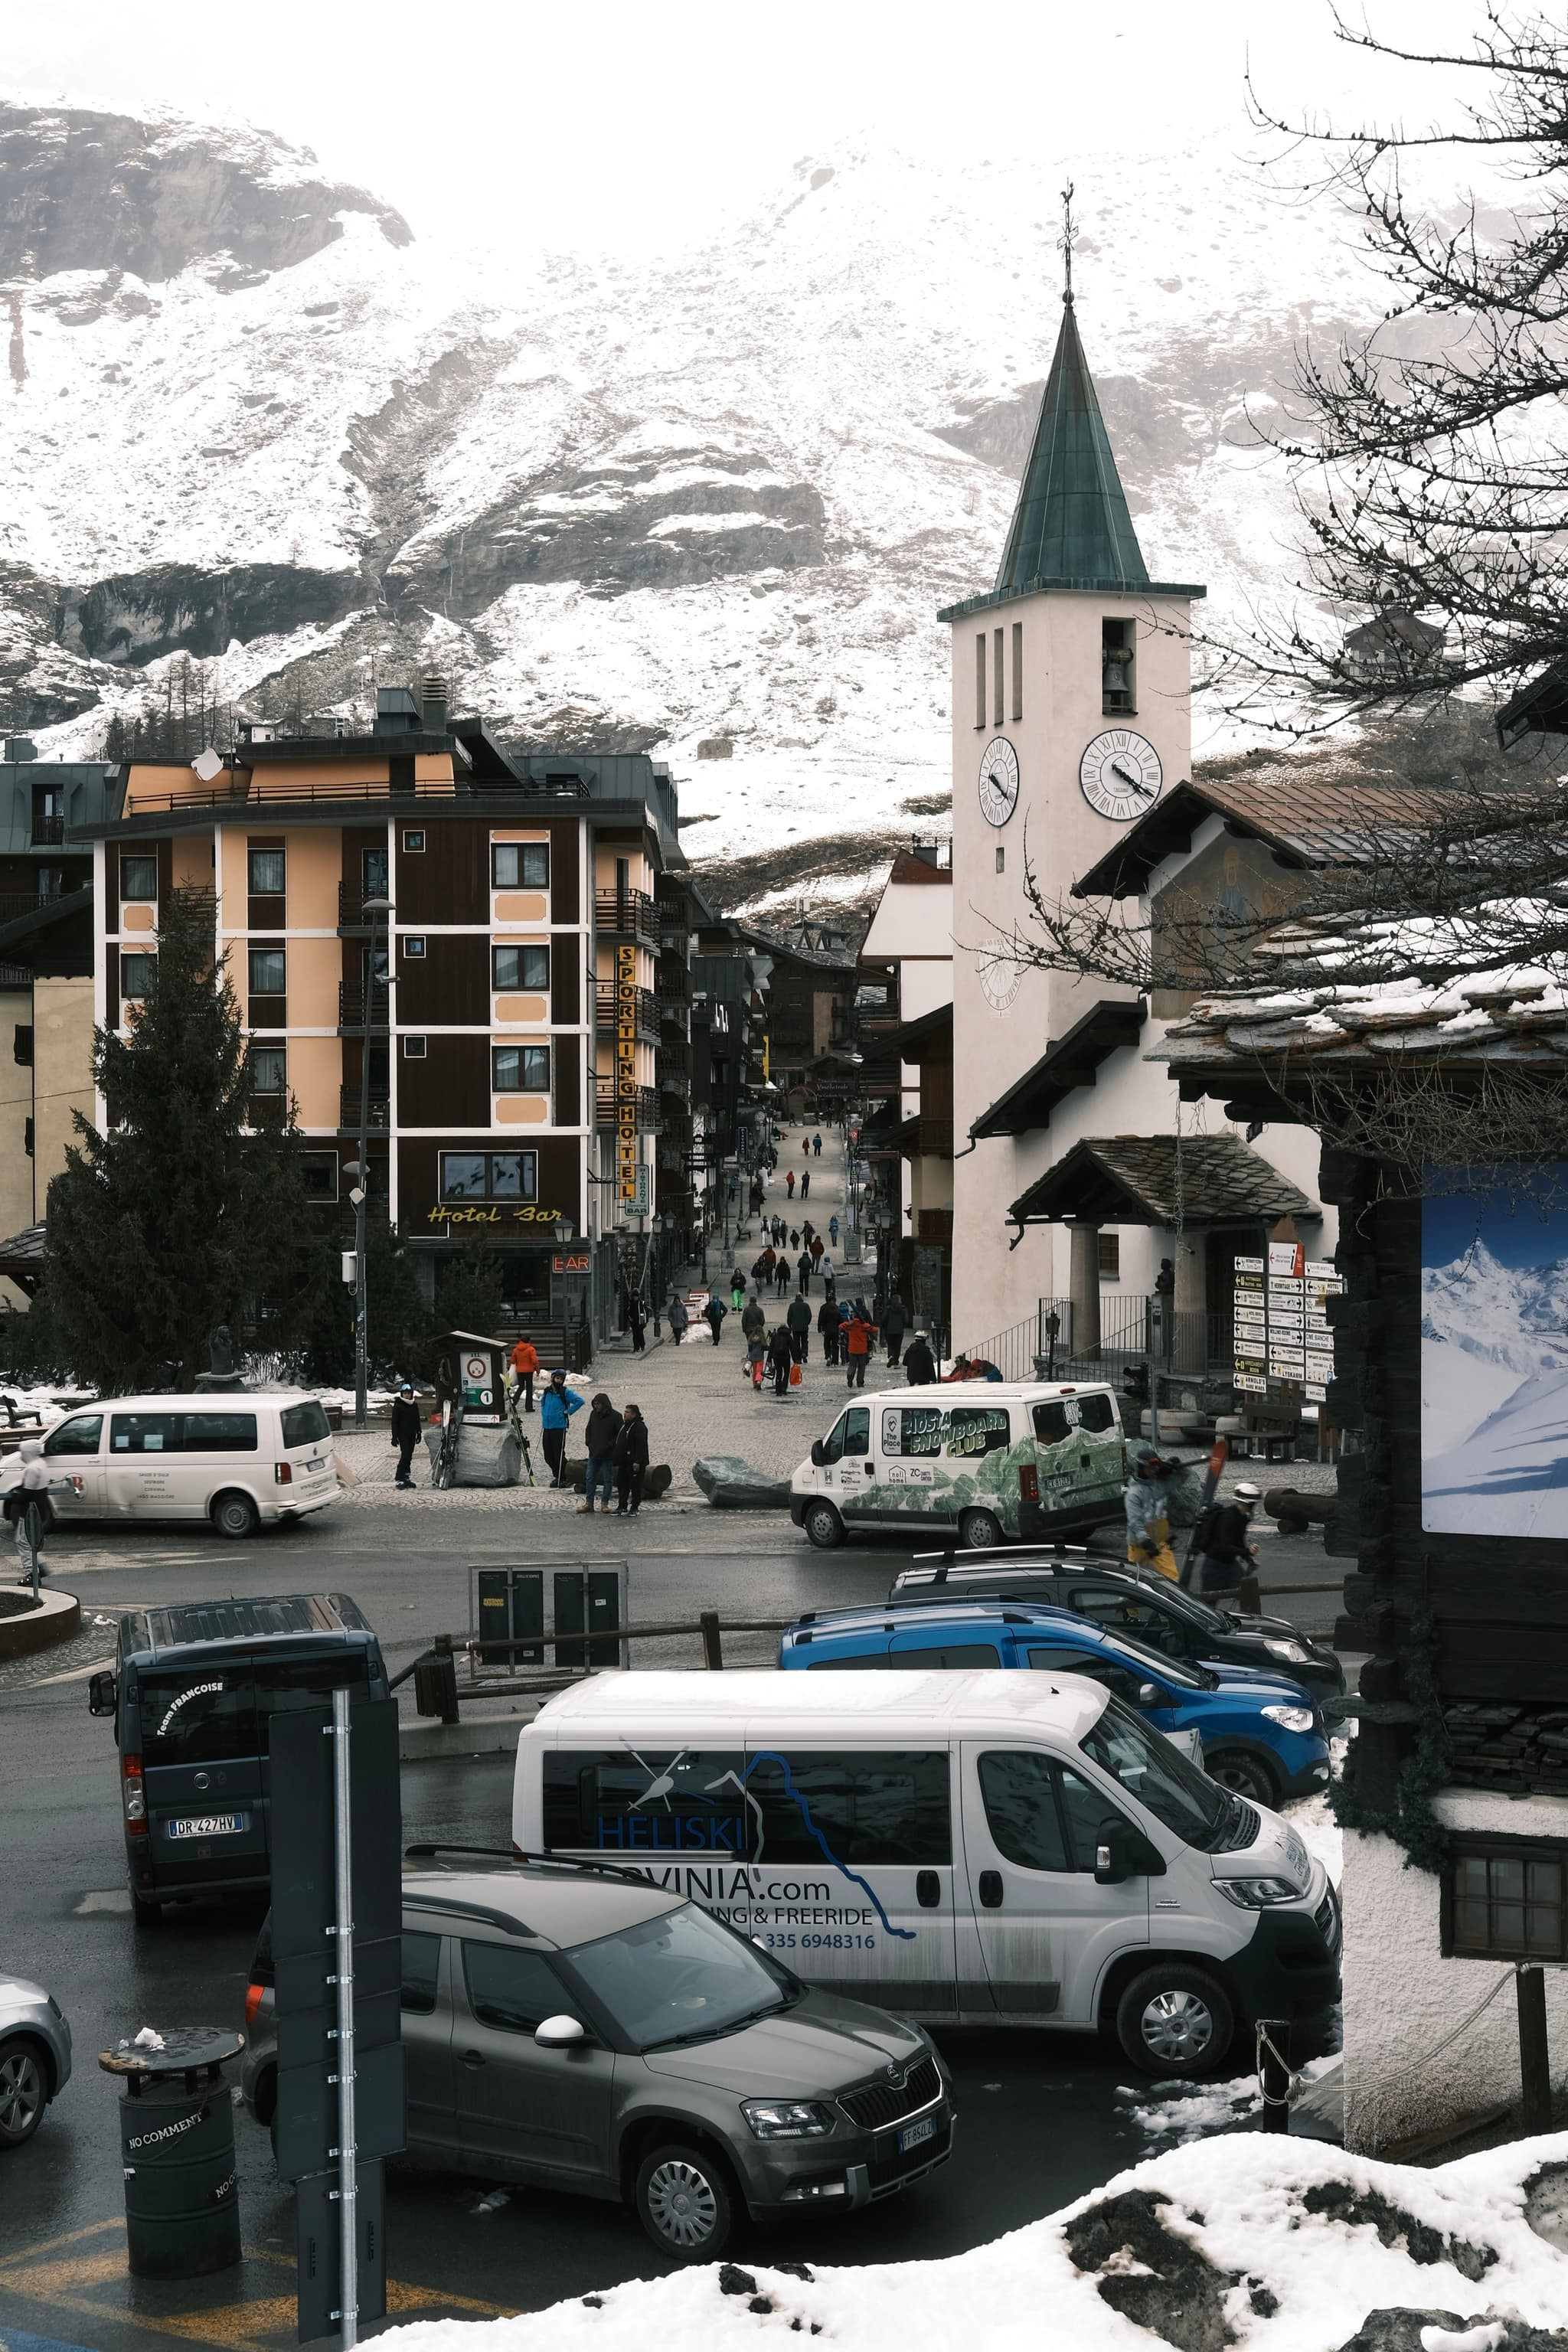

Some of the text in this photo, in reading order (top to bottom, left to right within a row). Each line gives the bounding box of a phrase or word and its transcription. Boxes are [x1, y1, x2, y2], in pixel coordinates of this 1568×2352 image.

[619, 948, 634, 1197] SPORTING HOTEL
[427, 1206, 562, 1223] Hotel Bar
[906, 1411, 952, 1434] AOSTA
[910, 1414, 1007, 1453] SNOWBOARD
[946, 1433, 986, 1458] CLUB
[156, 1682, 224, 1736] Team FRANCOISE
[178, 1816, 233, 1834] DR 427HV
[598, 1816, 743, 1850] HELISKI
[577, 1867, 830, 1901] VINIA.com
[754, 1907, 769, 1924] &
[776, 1908, 873, 1925] FREERIDE
[766, 1933, 796, 1949] 335
[802, 1933, 875, 1949] 6948316
[129, 2112, 203, 2149] NO COMMENT
[215, 2182, 229, 2199] NO
